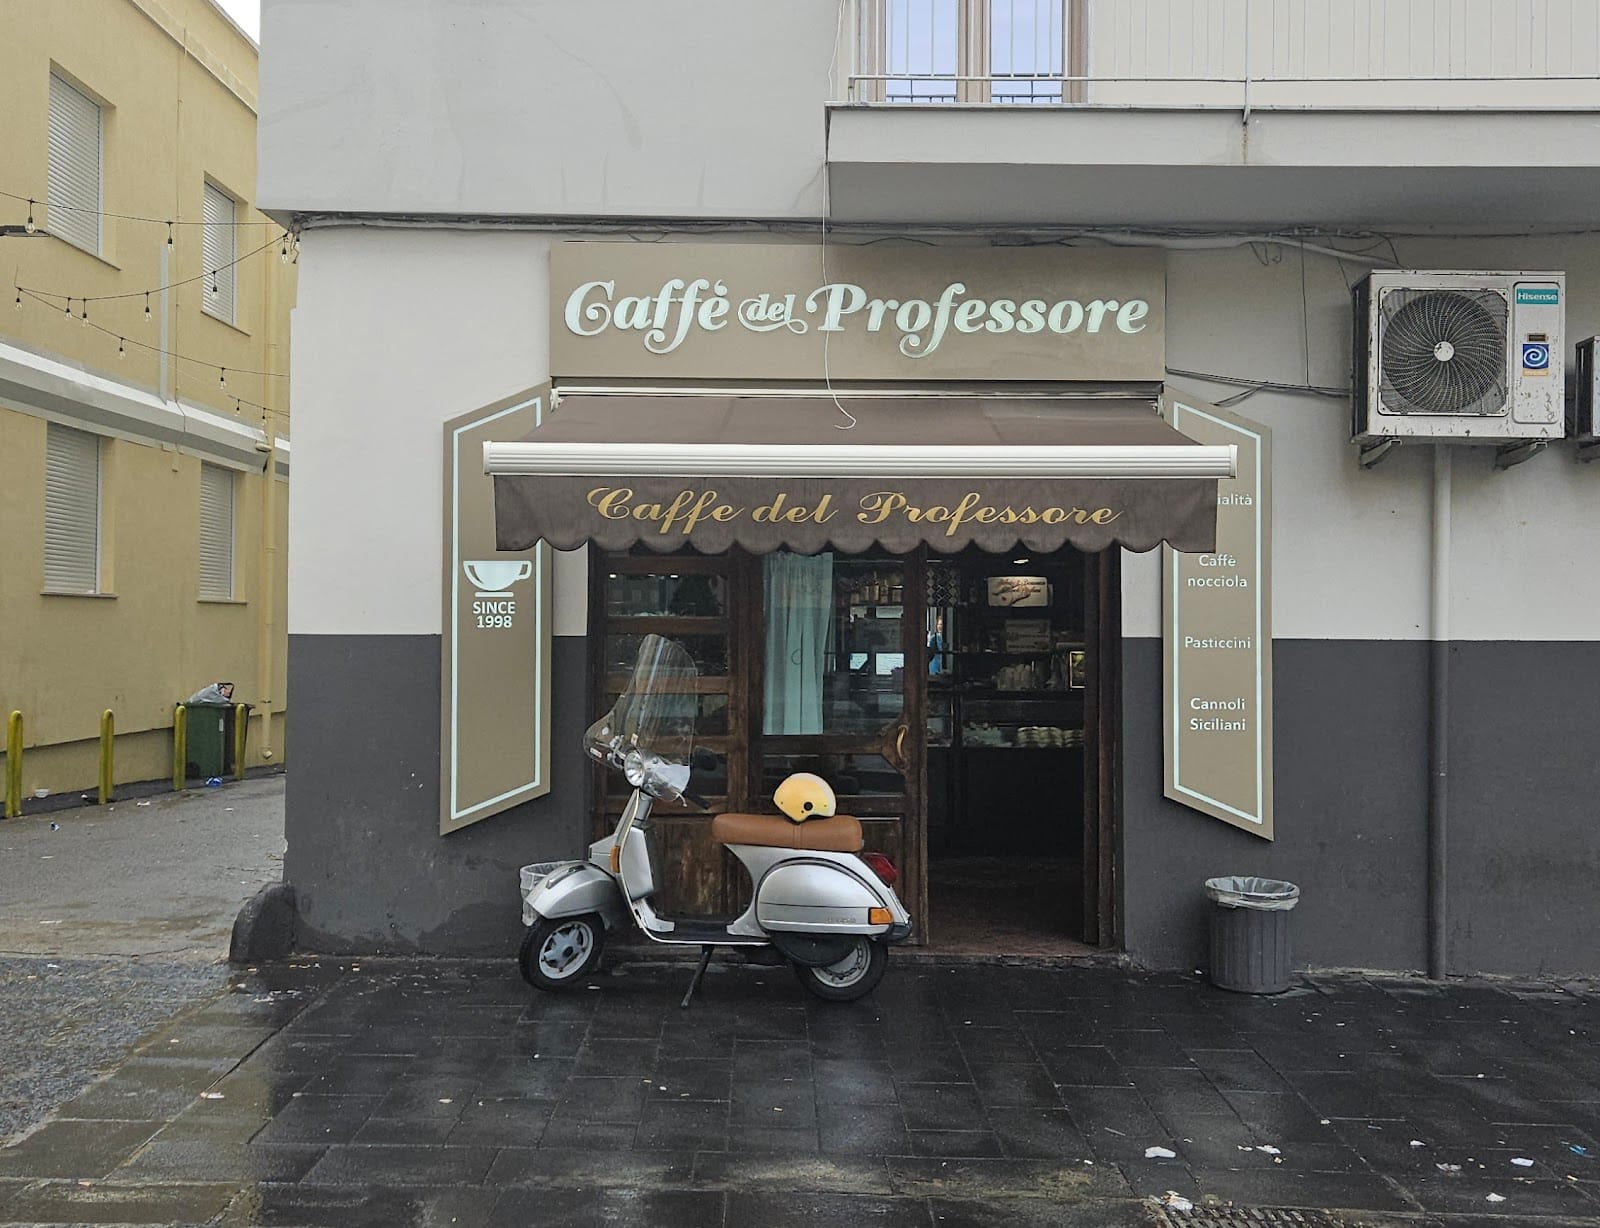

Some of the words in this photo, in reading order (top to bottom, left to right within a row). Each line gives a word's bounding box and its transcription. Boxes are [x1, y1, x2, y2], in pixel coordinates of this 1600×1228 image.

[1517, 291, 1558, 301] Hisense
[564, 278, 730, 354] Caffè
[737, 293, 809, 335] del
[805, 282, 1149, 358] Professore
[1217, 493, 1253, 506] ialità
[586, 487, 743, 534] Caffe
[752, 493, 838, 524] del
[857, 491, 1124, 537] Professore
[1198, 554, 1237, 567] Caffè
[1187, 574, 1248, 588] nocciola
[472, 601, 516, 614] SINCE
[477, 615, 513, 628] 1998
[1184, 636, 1251, 649] Pasticcini
[1190, 697, 1245, 711] Cannoli
[1190, 717, 1246, 731] Siciliani
